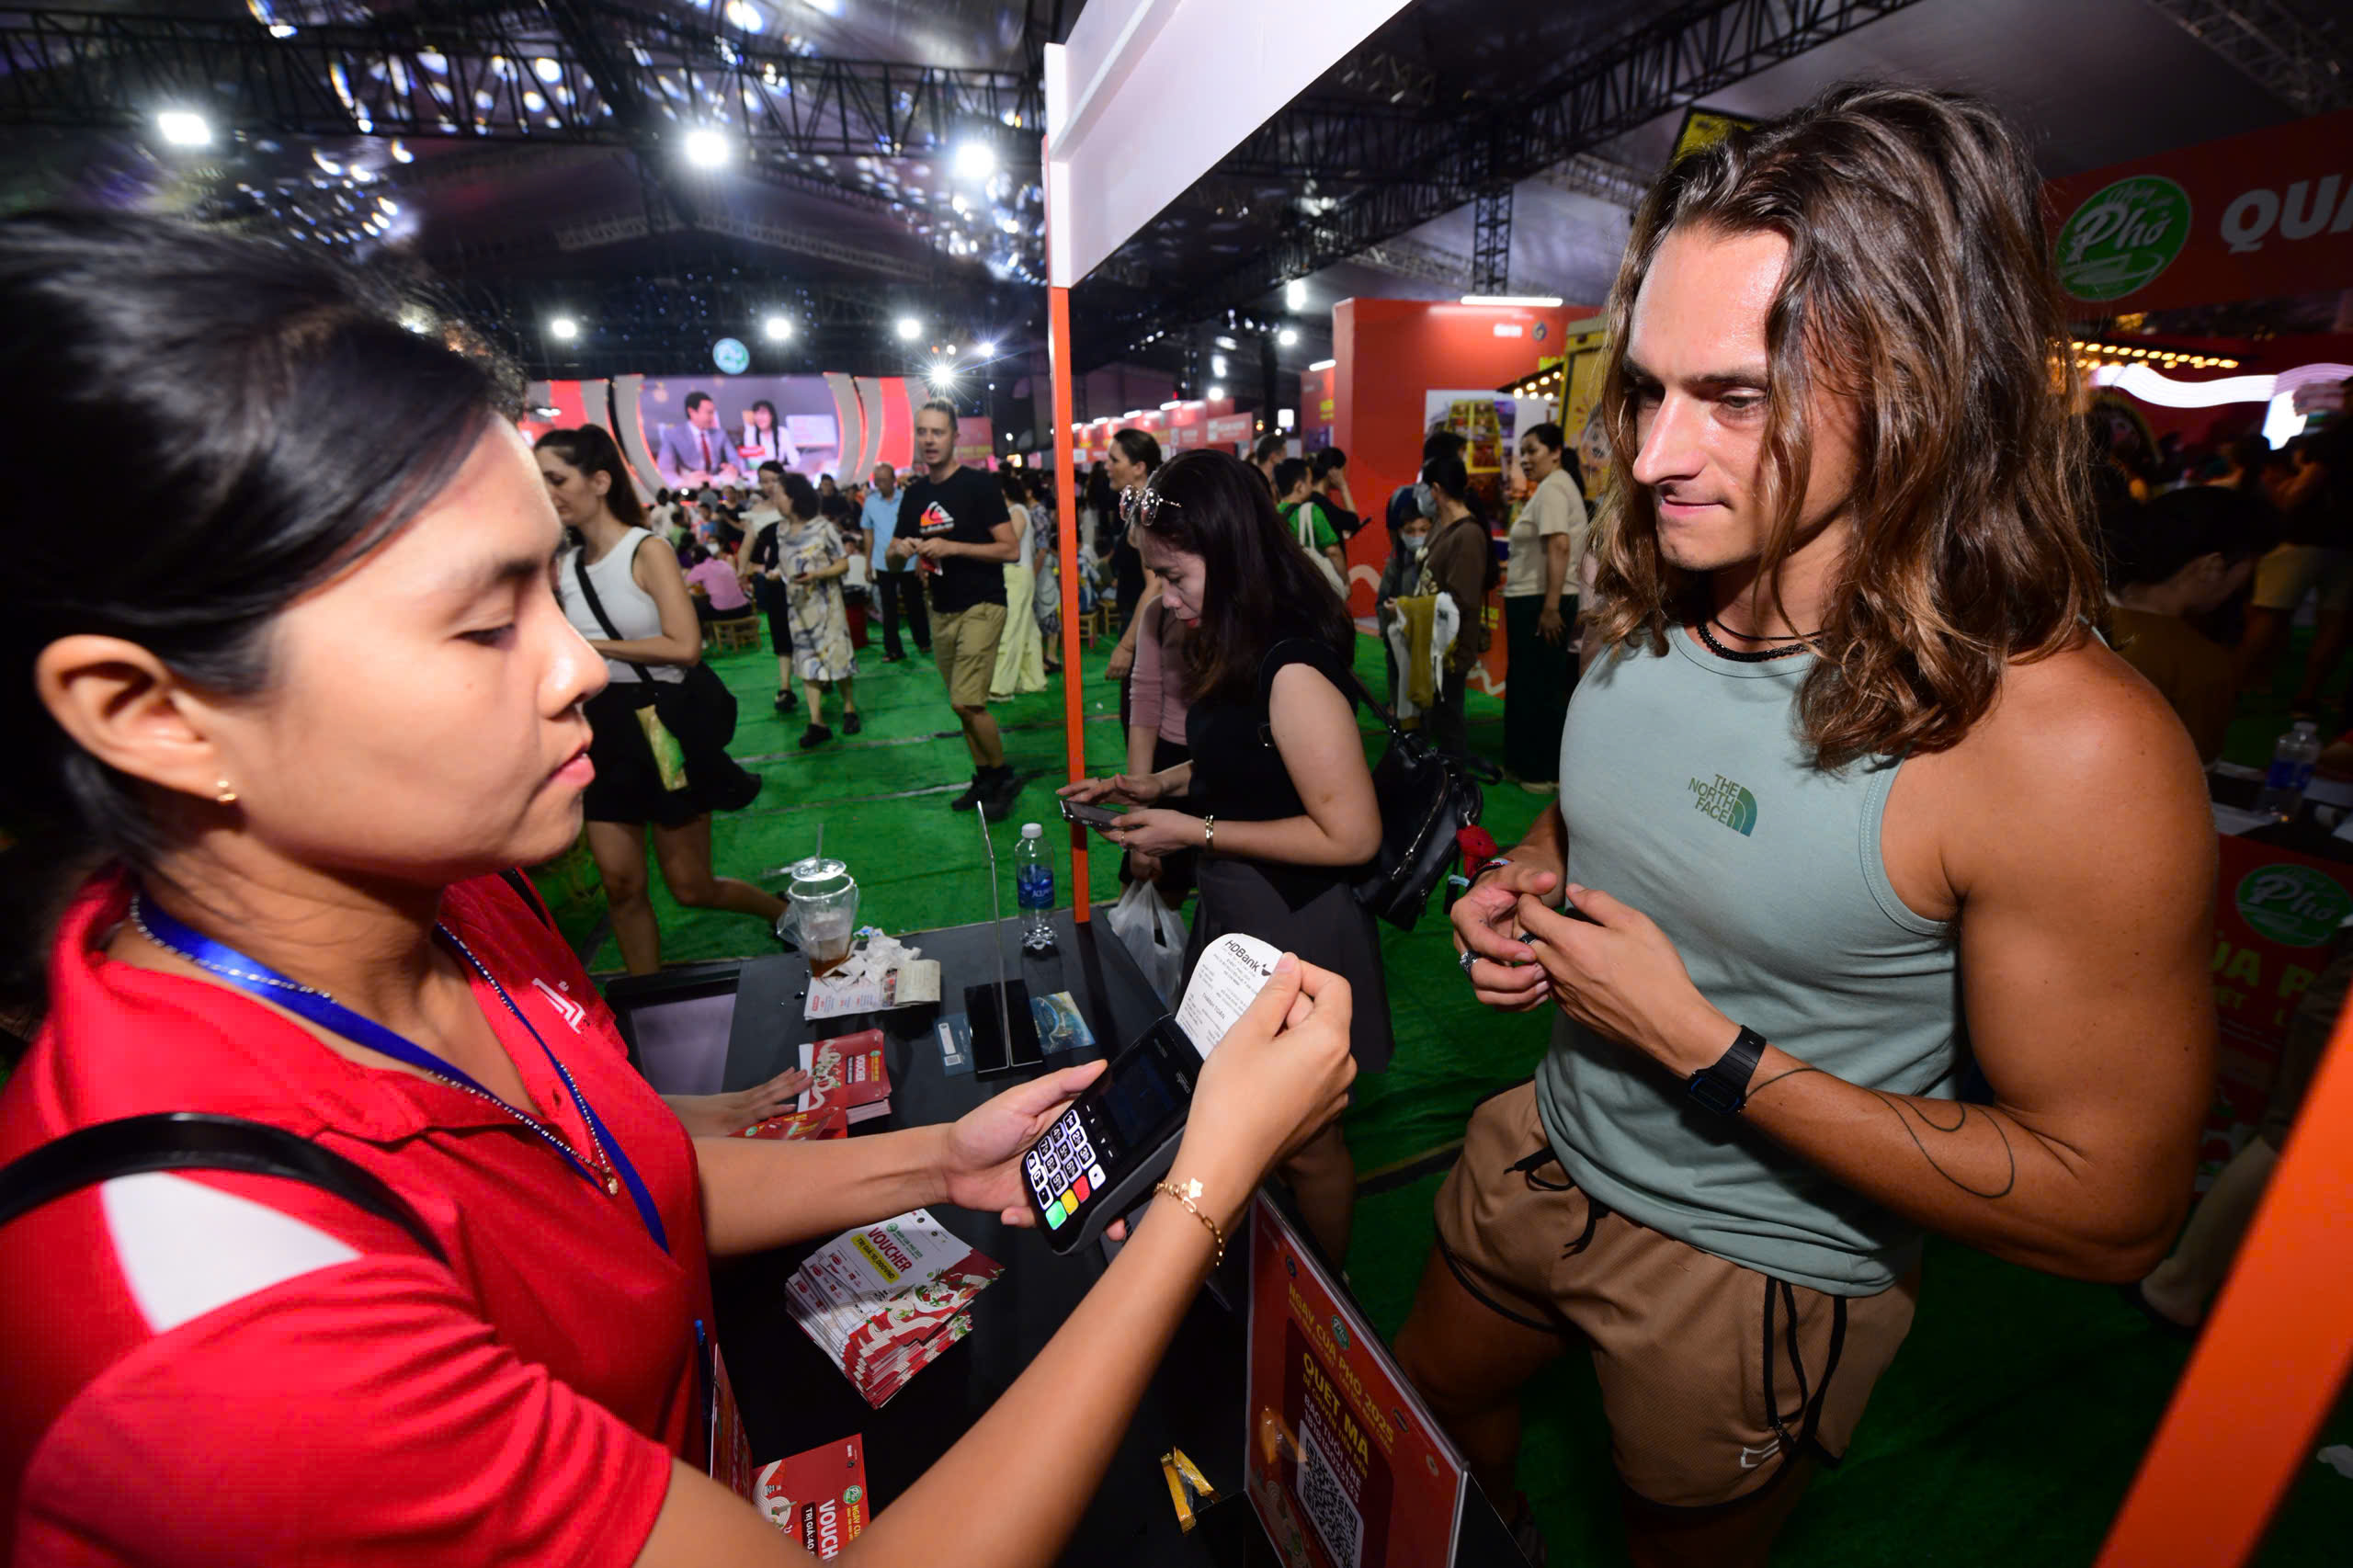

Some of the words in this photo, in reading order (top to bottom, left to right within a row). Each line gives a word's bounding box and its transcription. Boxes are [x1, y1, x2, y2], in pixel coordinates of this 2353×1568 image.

[1688, 777, 1735, 812] NORTH
[1713, 774, 1740, 798] THE
[1695, 796, 1729, 824] FACE
[1224, 939, 1260, 972] HDBank
[868, 1227, 913, 1273] VOUCHER
[1364, 1392, 1394, 1444] 2025
